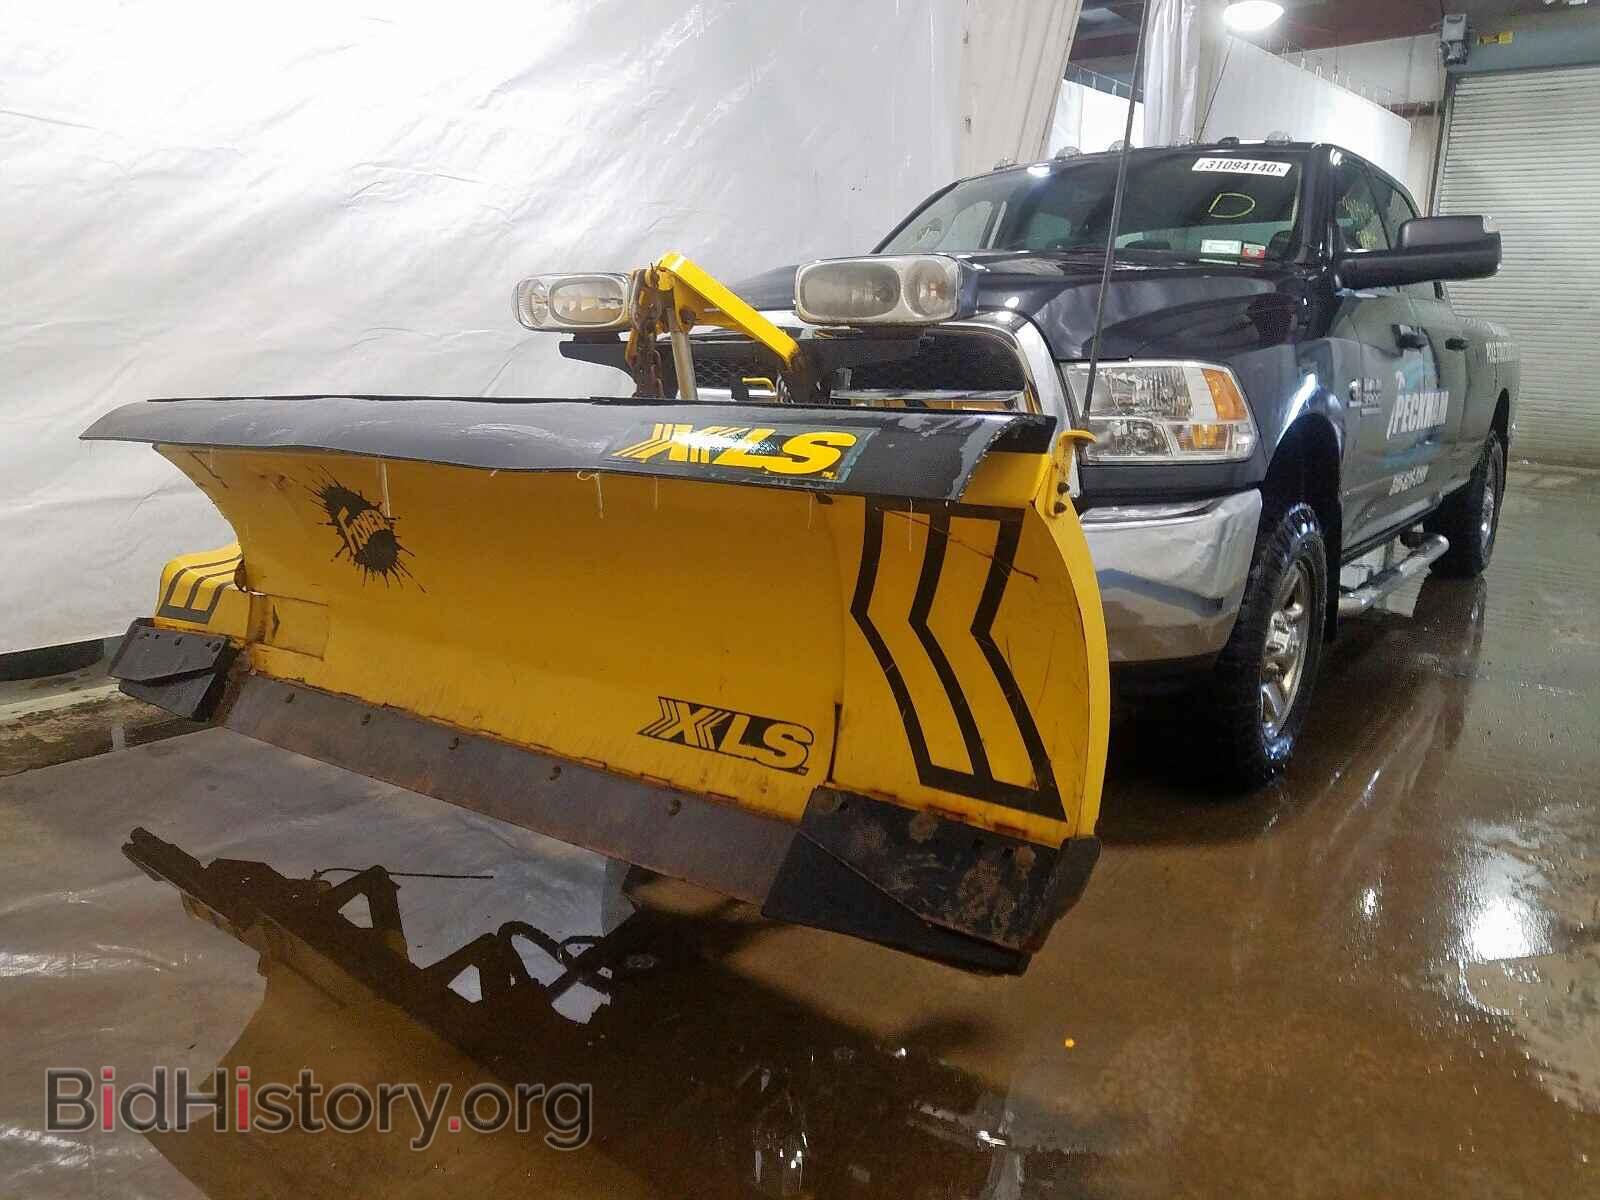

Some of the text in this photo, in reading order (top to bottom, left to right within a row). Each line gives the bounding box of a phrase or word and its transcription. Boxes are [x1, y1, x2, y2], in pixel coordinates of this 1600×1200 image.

[1205, 160, 1277, 173] 31094140
[611, 423, 858, 475] XLS
[637, 697, 814, 772] XLS
